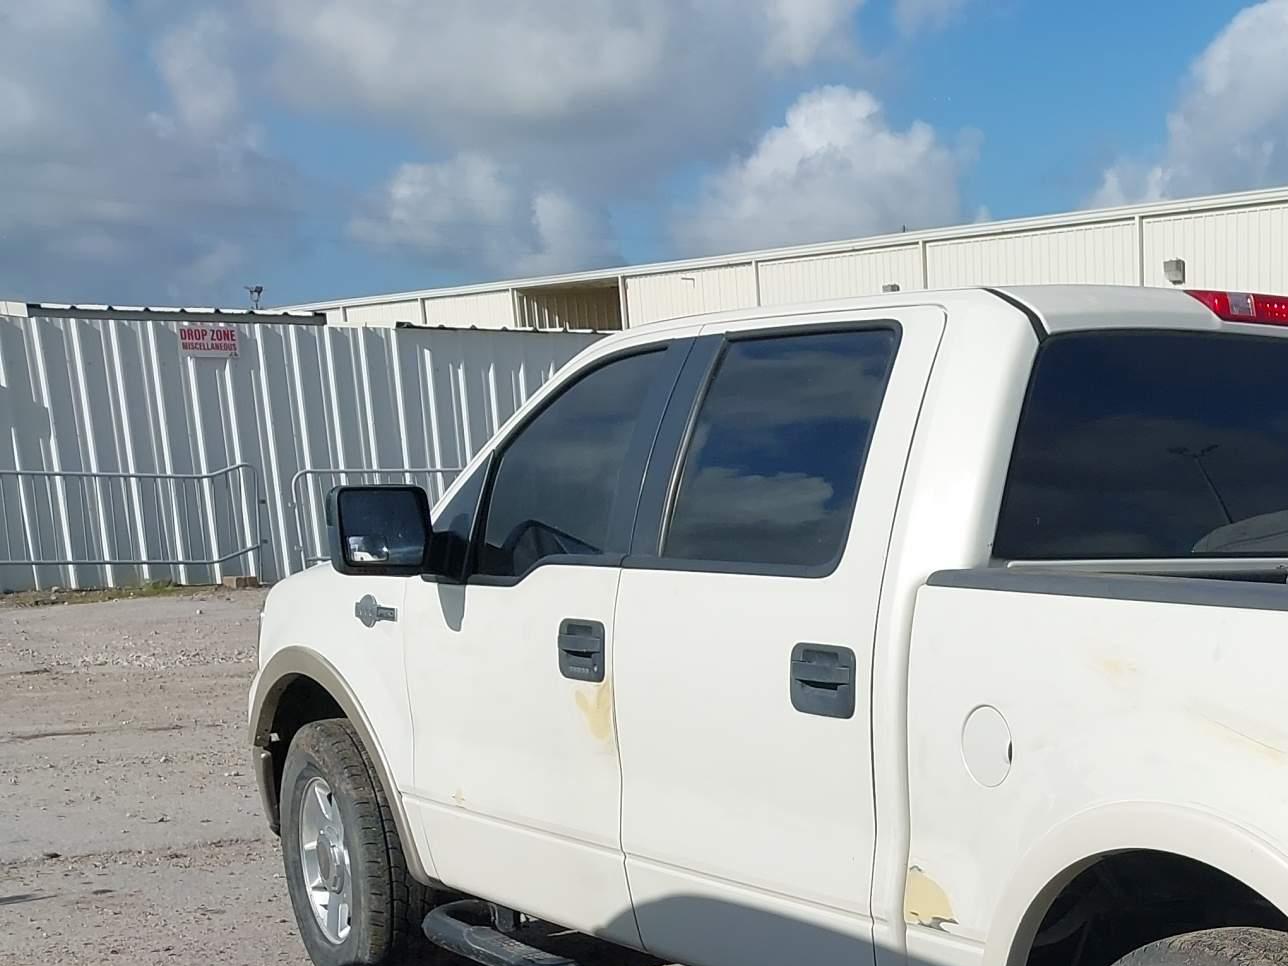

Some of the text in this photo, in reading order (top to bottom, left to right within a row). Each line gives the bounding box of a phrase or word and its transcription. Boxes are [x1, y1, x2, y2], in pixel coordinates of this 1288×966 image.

[180, 329, 237, 342] DROP ZONE
[181, 341, 238, 352] MISCELLANEOUS
